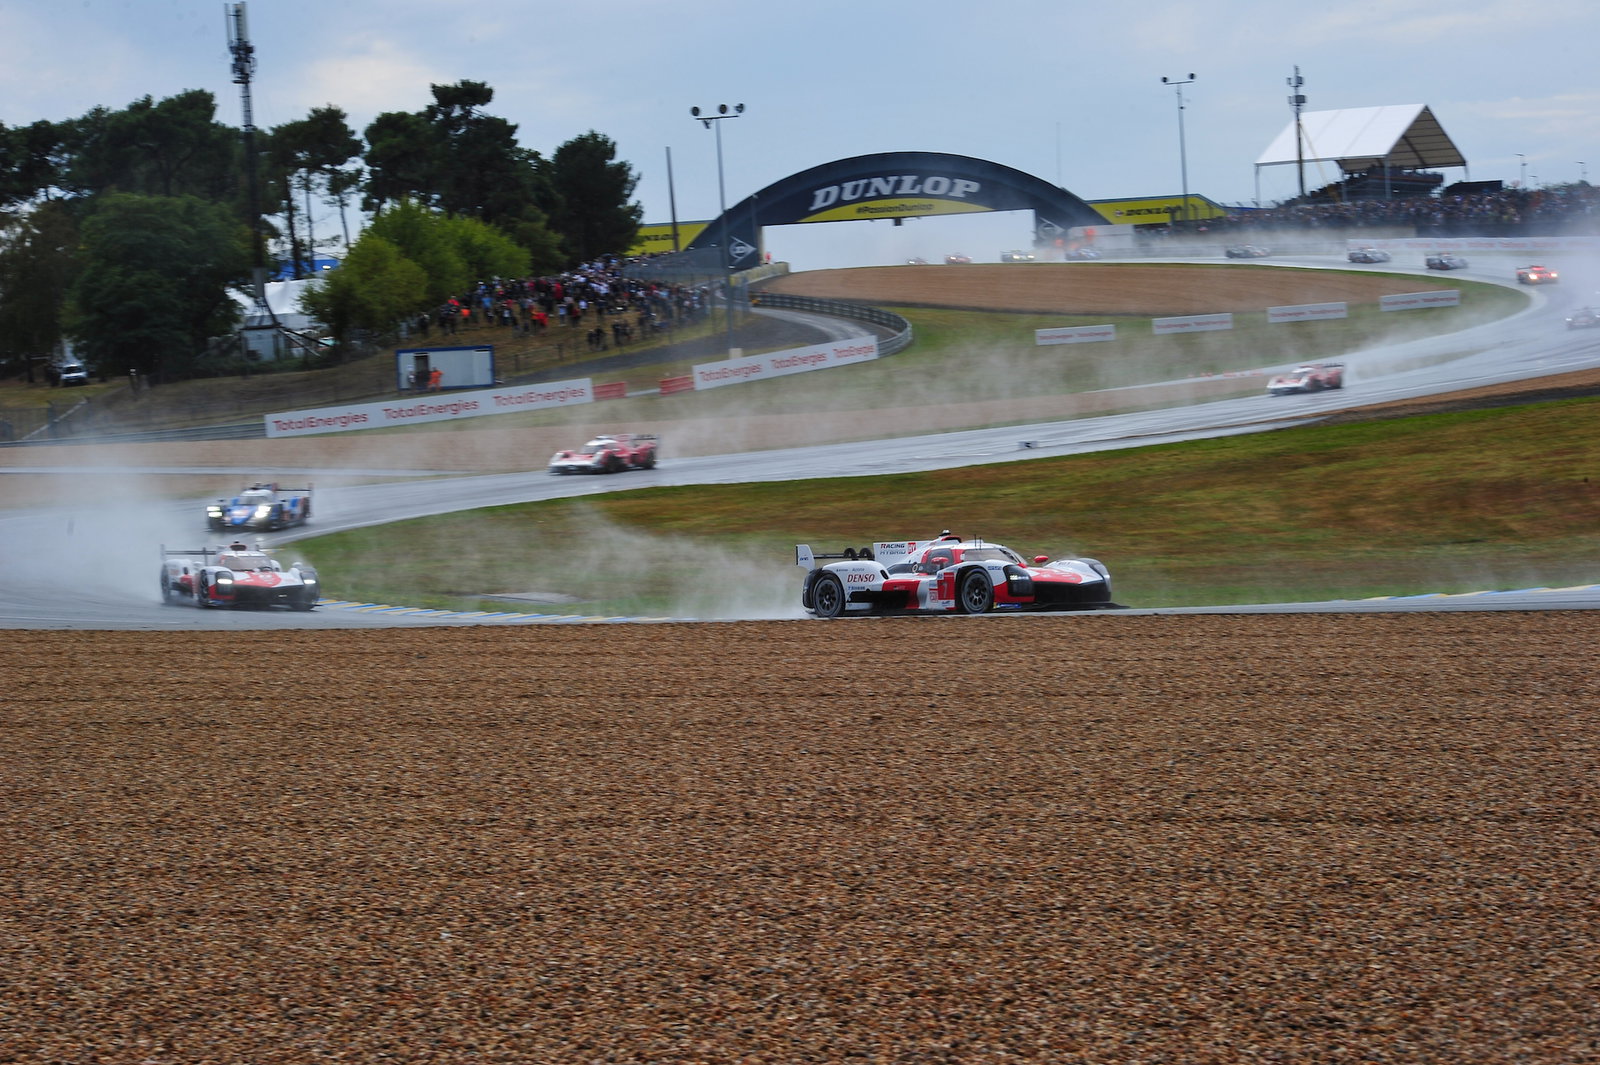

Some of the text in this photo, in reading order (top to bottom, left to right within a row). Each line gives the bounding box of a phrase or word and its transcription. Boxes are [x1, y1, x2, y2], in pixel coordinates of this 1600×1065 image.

[808, 175, 981, 211] DUNLOP
[699, 363, 762, 381] TotalEnergies
[770, 352, 827, 369] TotalEnergies
[272, 387, 586, 431] TotalEnergies TotalEnergies TotalEnergies
[847, 573, 875, 583] DENSO
